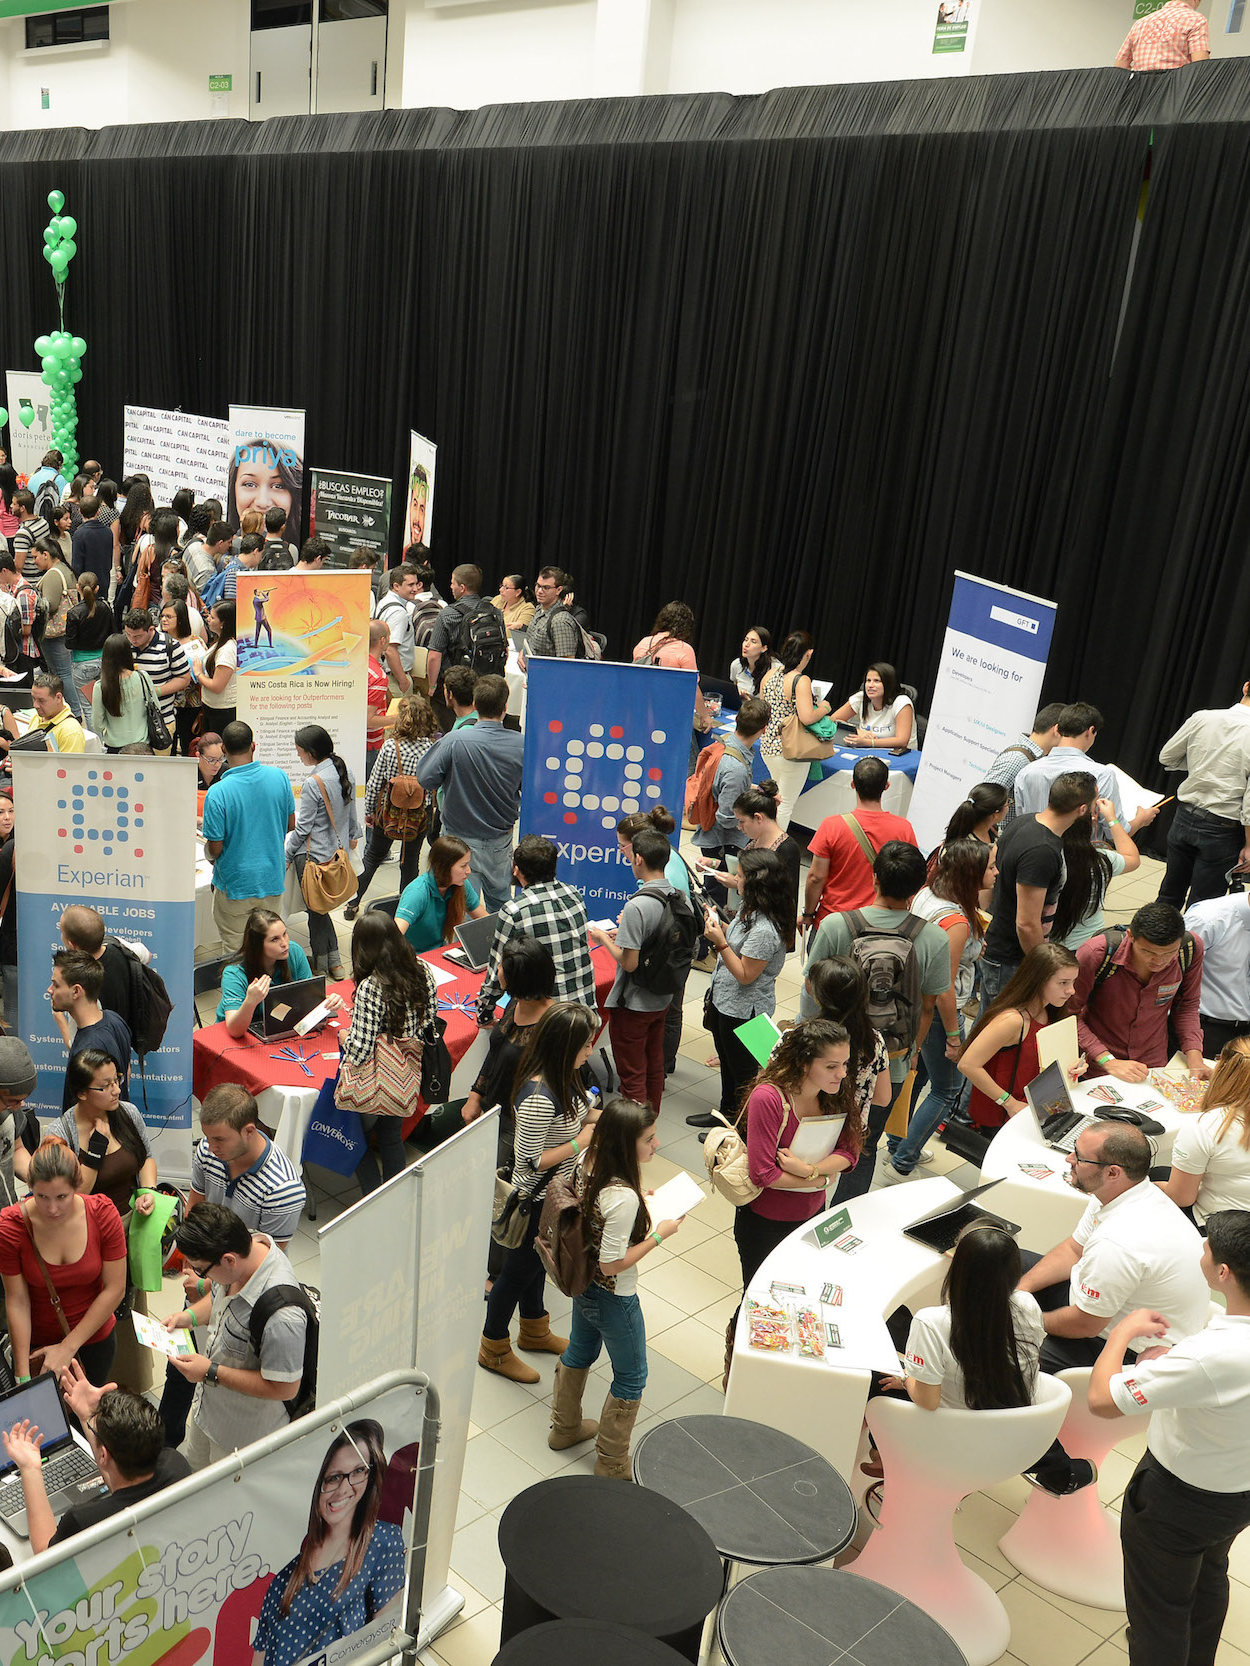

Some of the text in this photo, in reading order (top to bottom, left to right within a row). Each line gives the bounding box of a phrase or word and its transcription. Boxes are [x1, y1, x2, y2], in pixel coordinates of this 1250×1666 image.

[1135, 2, 1164, 14] C2-0
[137, 410, 156, 418] CAPITAL
[172, 414, 192, 424] CAPITAL
[12, 429, 33, 438] doris
[235, 429, 252, 438] dare
[265, 432, 296, 440] become
[235, 441, 296, 470] priya
[318, 480, 384, 499] ¿BUSCAS EMPLEO?
[1016, 618, 1030, 628] GFT
[952, 646, 1024, 684] We are looking for
[952, 669, 973, 682] Developers
[332, 680, 354, 688] Hiring!
[270, 694, 292, 702] looking
[302, 694, 344, 702] Outperformers
[942, 726, 963, 742] Application
[963, 735, 980, 748] Support
[986, 724, 1006, 738] Designers
[928, 762, 962, 782] Project Managers
[968, 760, 987, 774] Technical
[541, 834, 632, 867] xperi
[58, 864, 144, 888] Experian
[588, 887, 603, 898] of
[122, 907, 156, 920] JOBS
[310, 1120, 355, 1151] CONVERGYS
[14, 1511, 254, 1660] Your story
[163, 1553, 270, 1632] here.
